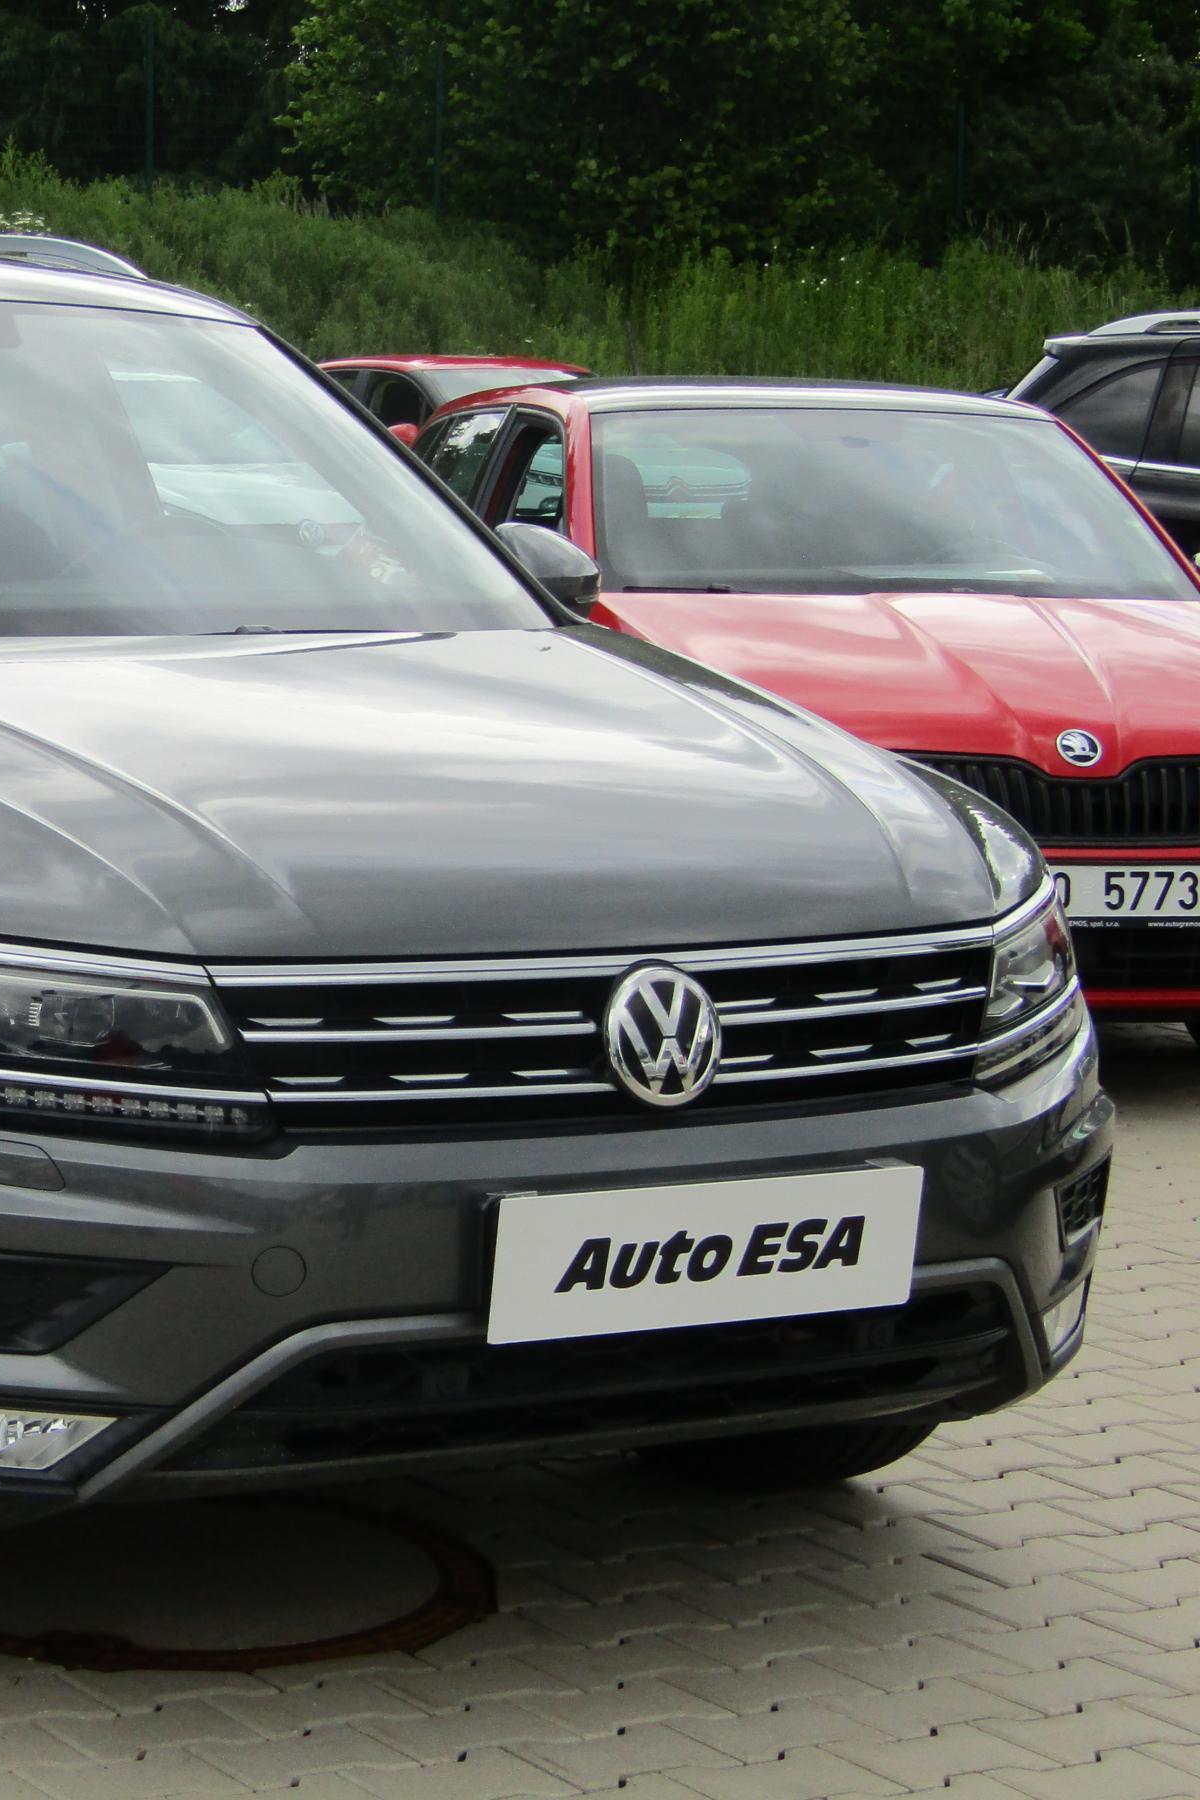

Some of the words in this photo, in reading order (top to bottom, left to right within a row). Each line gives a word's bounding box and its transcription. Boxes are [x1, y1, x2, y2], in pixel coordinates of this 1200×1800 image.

[1104, 871, 1199, 911] 5773
[553, 1230, 733, 1293] Auto
[736, 1215, 866, 1277] ESA
